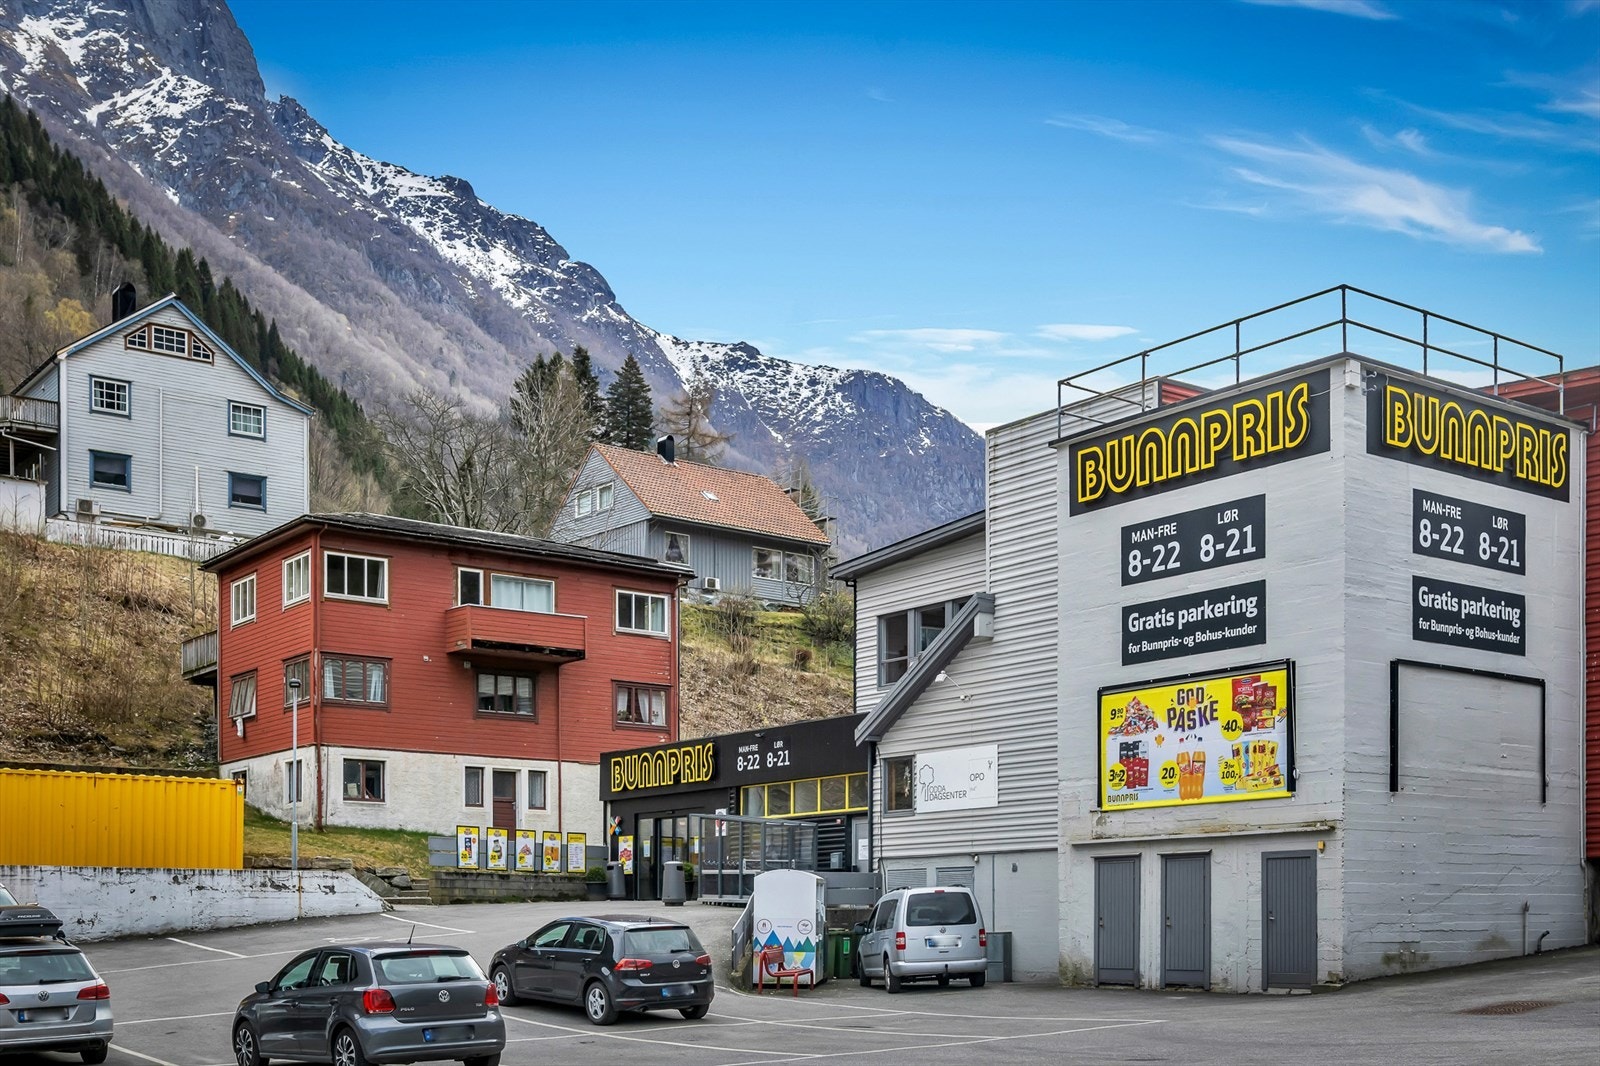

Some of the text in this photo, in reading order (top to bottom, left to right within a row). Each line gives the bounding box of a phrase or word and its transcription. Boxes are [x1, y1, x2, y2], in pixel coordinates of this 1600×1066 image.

[1077, 382, 1310, 503] BUNNPRIS
[1385, 384, 1567, 488] BUNNPRIS
[1217, 508, 1239, 525] LØR
[1422, 499, 1462, 520] MAN-FRE
[1131, 522, 1178, 544] MAN-FRE
[1492, 515, 1508, 531] LØR
[1200, 524, 1256, 562] 8-21
[1419, 518, 1464, 555] 8-22
[1479, 532, 1520, 567] 8-21
[1128, 541, 1181, 577] 8-22
[1128, 594, 1258, 632] Gratis parkering
[1418, 586, 1520, 628] Gratis parkering
[1128, 624, 1257, 654] for Bunnpris- og Bohus-kunder
[1419, 618, 1520, 644] for Bunnpris- og Bohus-kunder
[1167, 700, 1219, 732] PÅSKE
[738, 744, 759, 753] MAN-FRE
[773, 740, 784, 749] LØR
[611, 742, 714, 792] BUNNPRIS
[737, 754, 760, 772] 8-22
[766, 750, 790, 768] 8-21
[969, 772, 984, 781] OPO
[929, 790, 967, 801] DAGSENTER
[1107, 793, 1139, 803] BUNNPRIS
